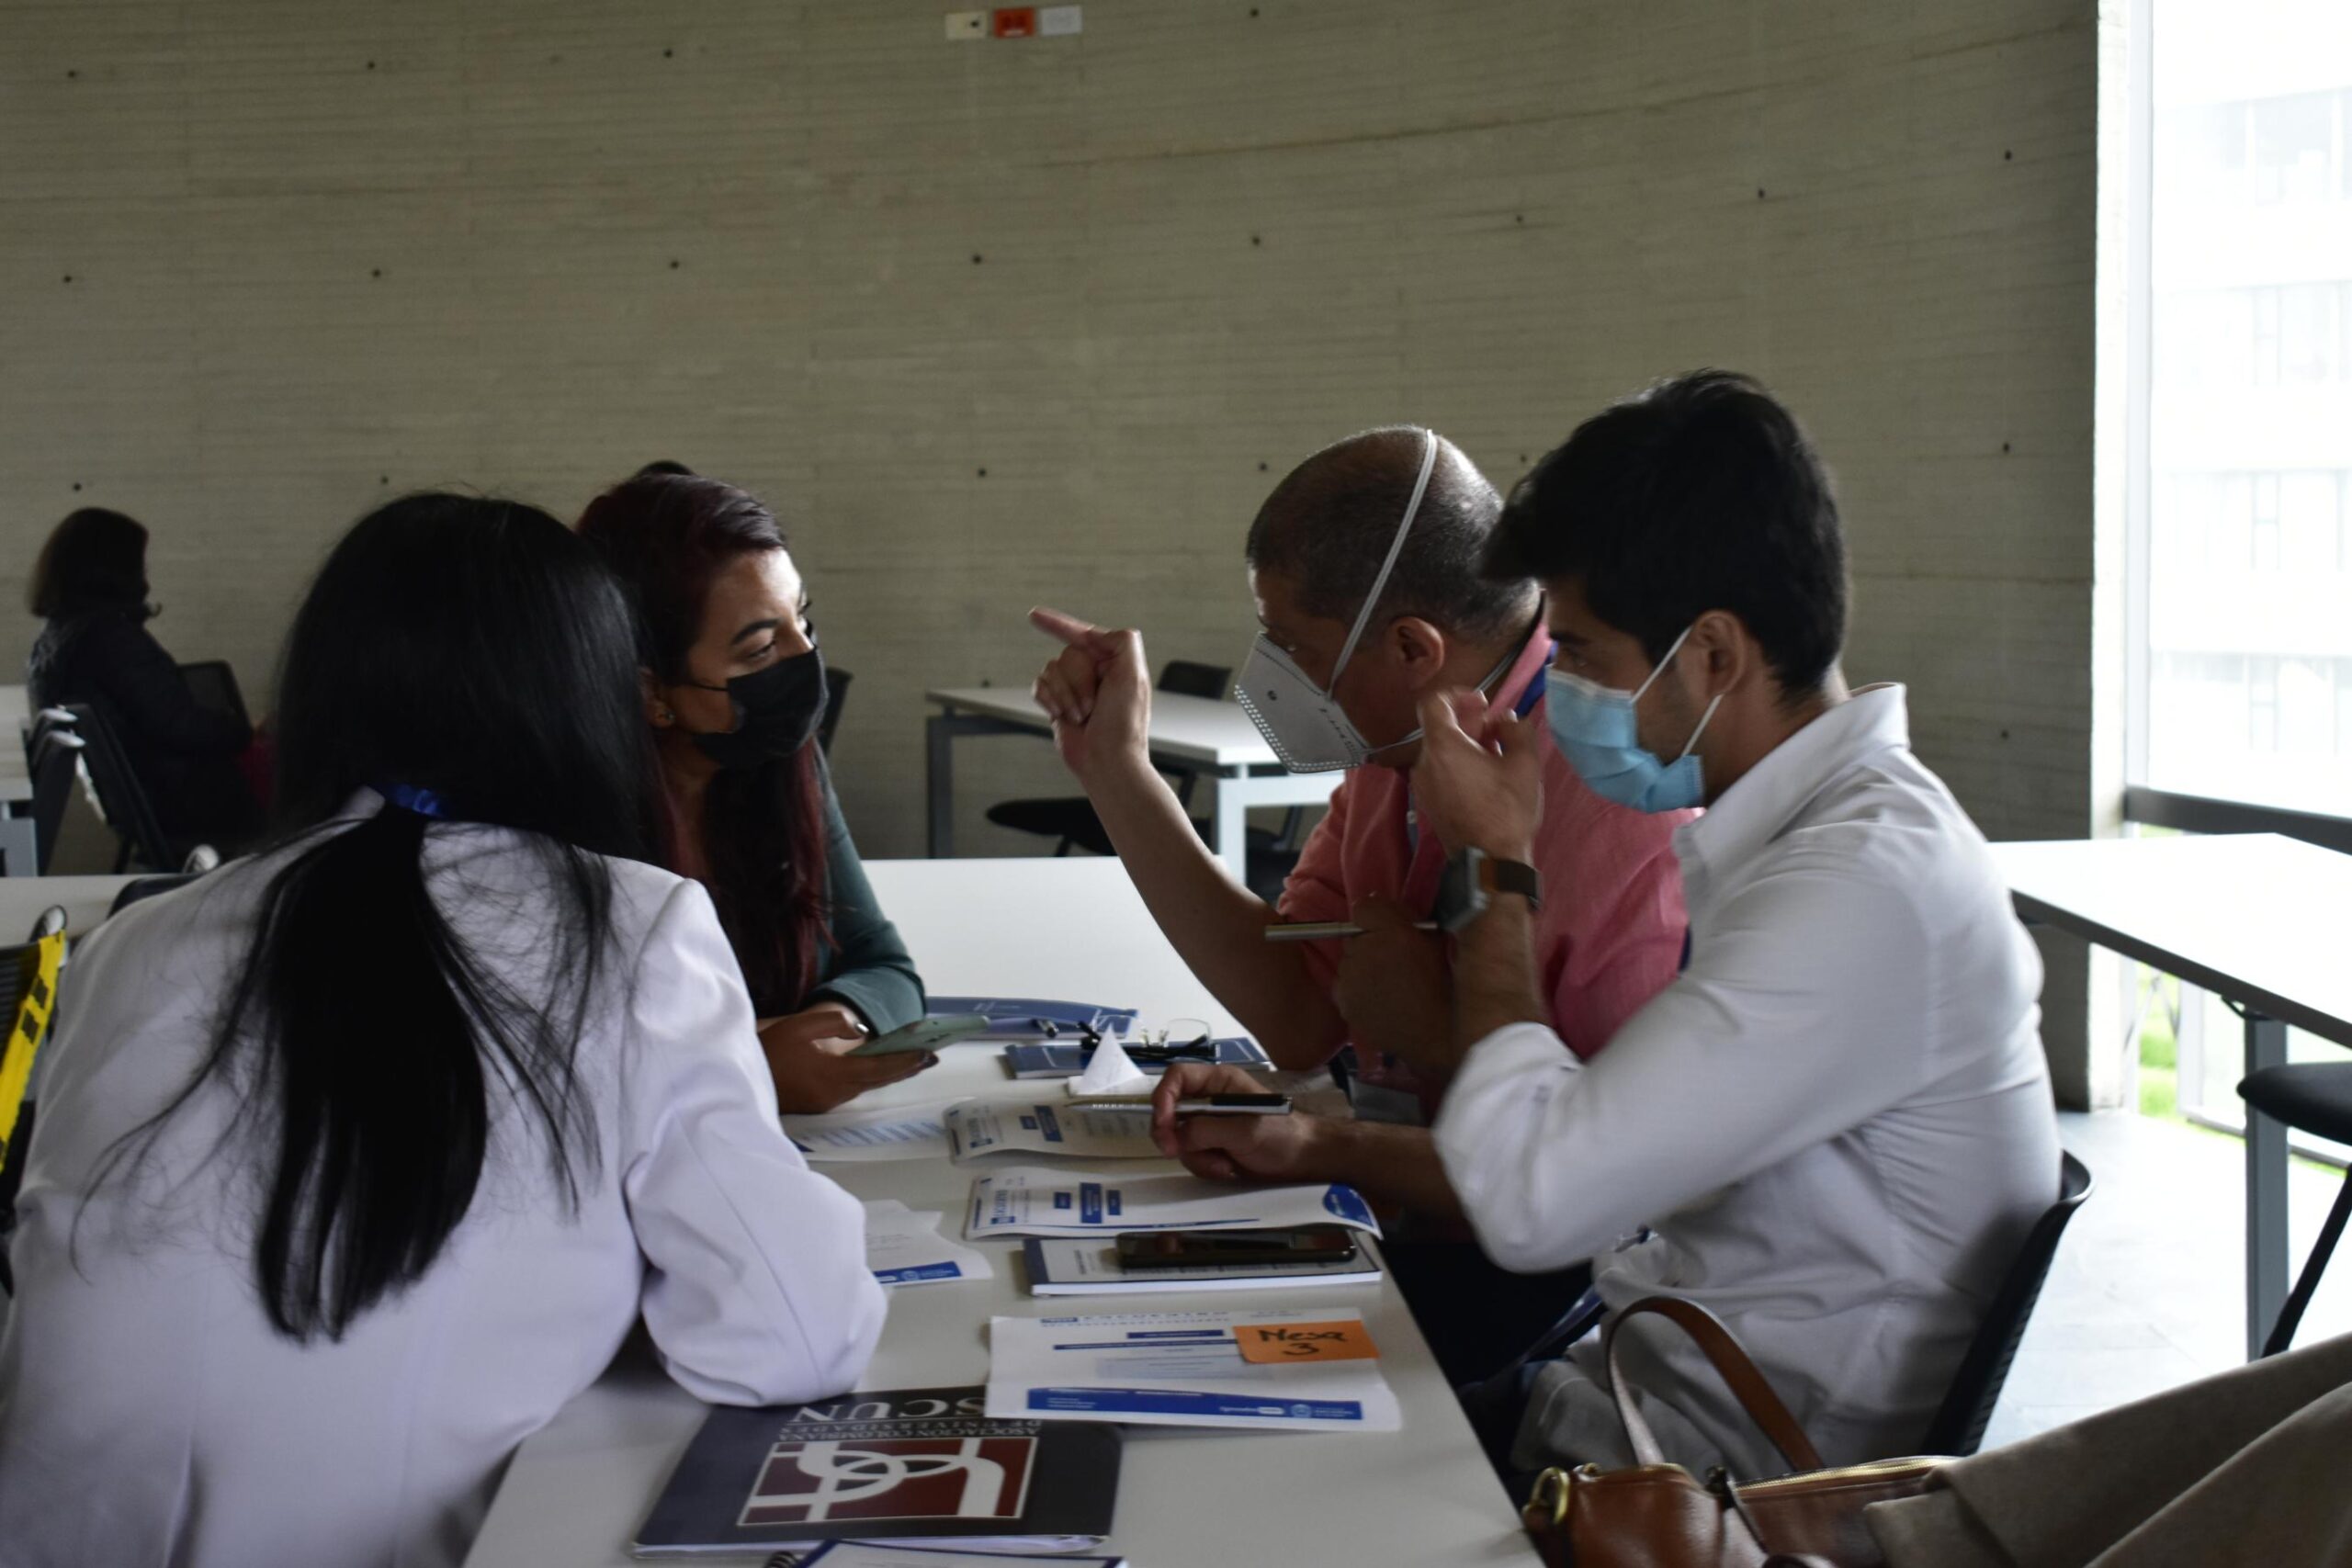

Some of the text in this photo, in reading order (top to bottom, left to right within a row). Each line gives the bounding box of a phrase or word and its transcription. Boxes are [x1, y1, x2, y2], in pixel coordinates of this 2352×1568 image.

[1258, 1328, 1348, 1341] Mesa
[1282, 1342, 1319, 1355] 3
[791, 1397, 985, 1423] SCUN
[778, 1430, 911, 1441] COLOMBIANA
